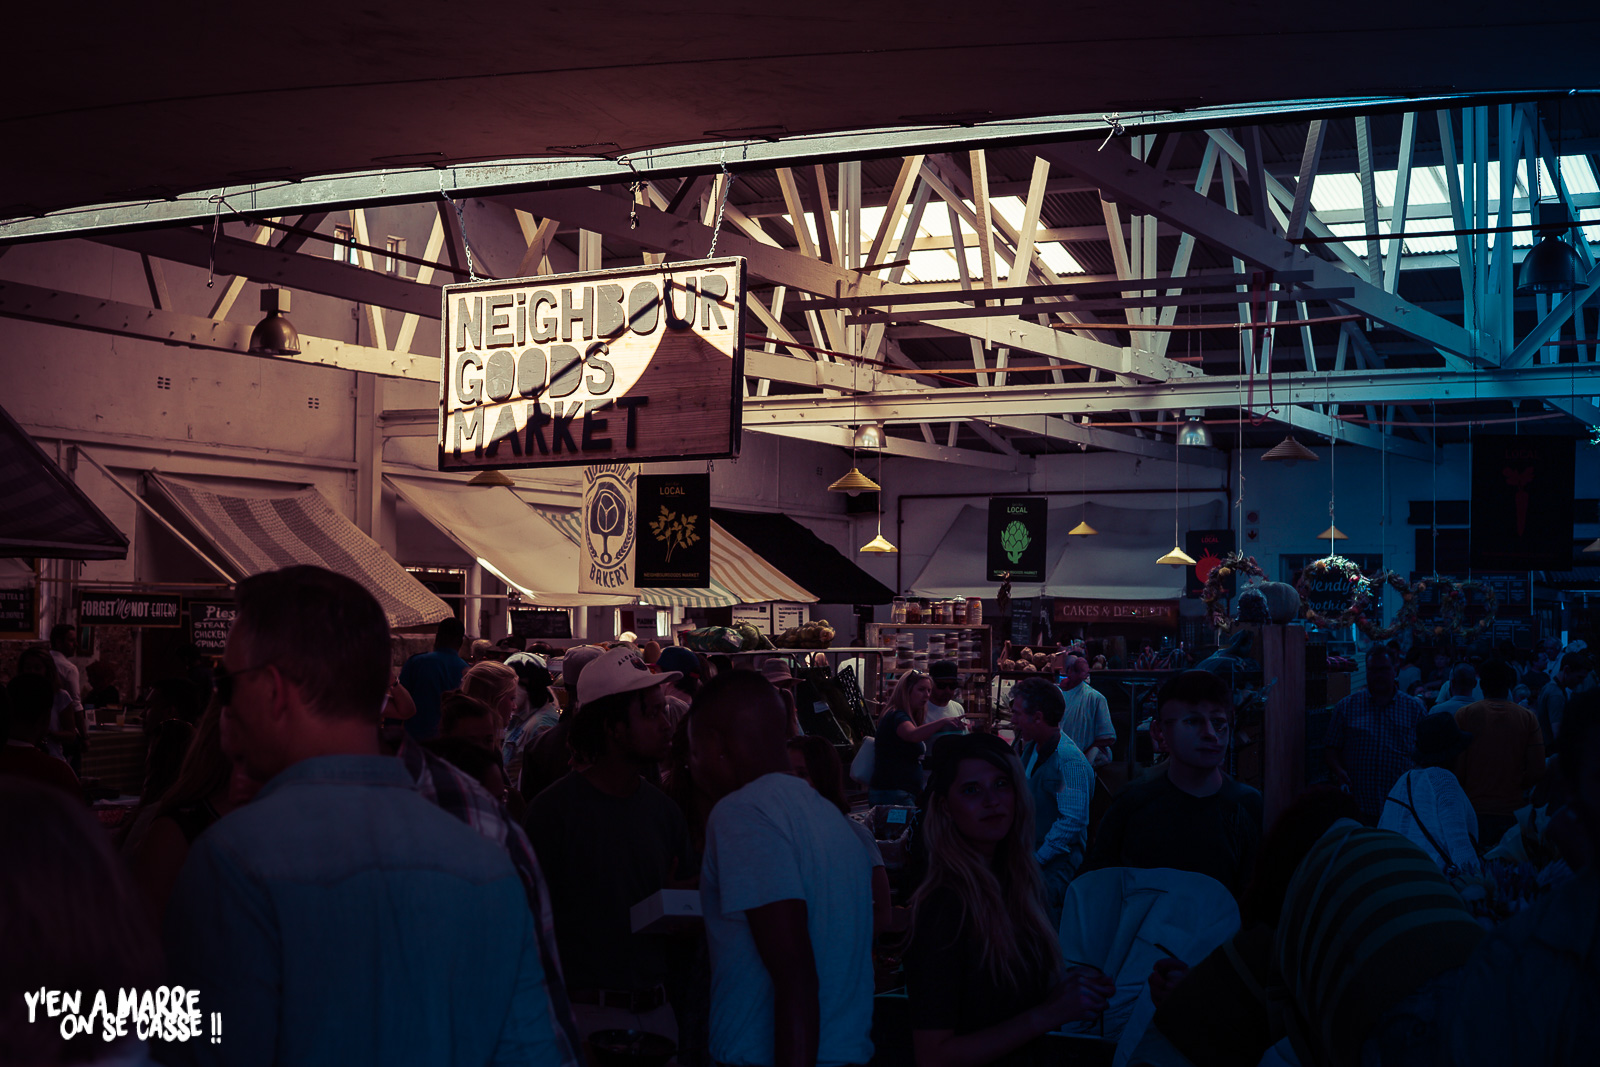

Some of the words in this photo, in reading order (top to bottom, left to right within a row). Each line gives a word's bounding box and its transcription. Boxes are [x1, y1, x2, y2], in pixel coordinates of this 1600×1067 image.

[455, 341, 615, 406] GOODS
[453, 396, 649, 459] MARKET
[659, 486, 686, 496] LOCAL
[1007, 506, 1028, 514] LOCAL
[589, 562, 629, 588] BAKERY
[81, 600, 116, 616] FORGET
[115, 597, 131, 620] Me
[131, 601, 149, 618] NOT
[205, 605, 236, 620] Pies
[1062, 605, 1100, 616] CAKES
[1101, 605, 1110, 616] &
[193, 621, 226, 629] STEAK
[194, 630, 227, 639] CHICKEN
